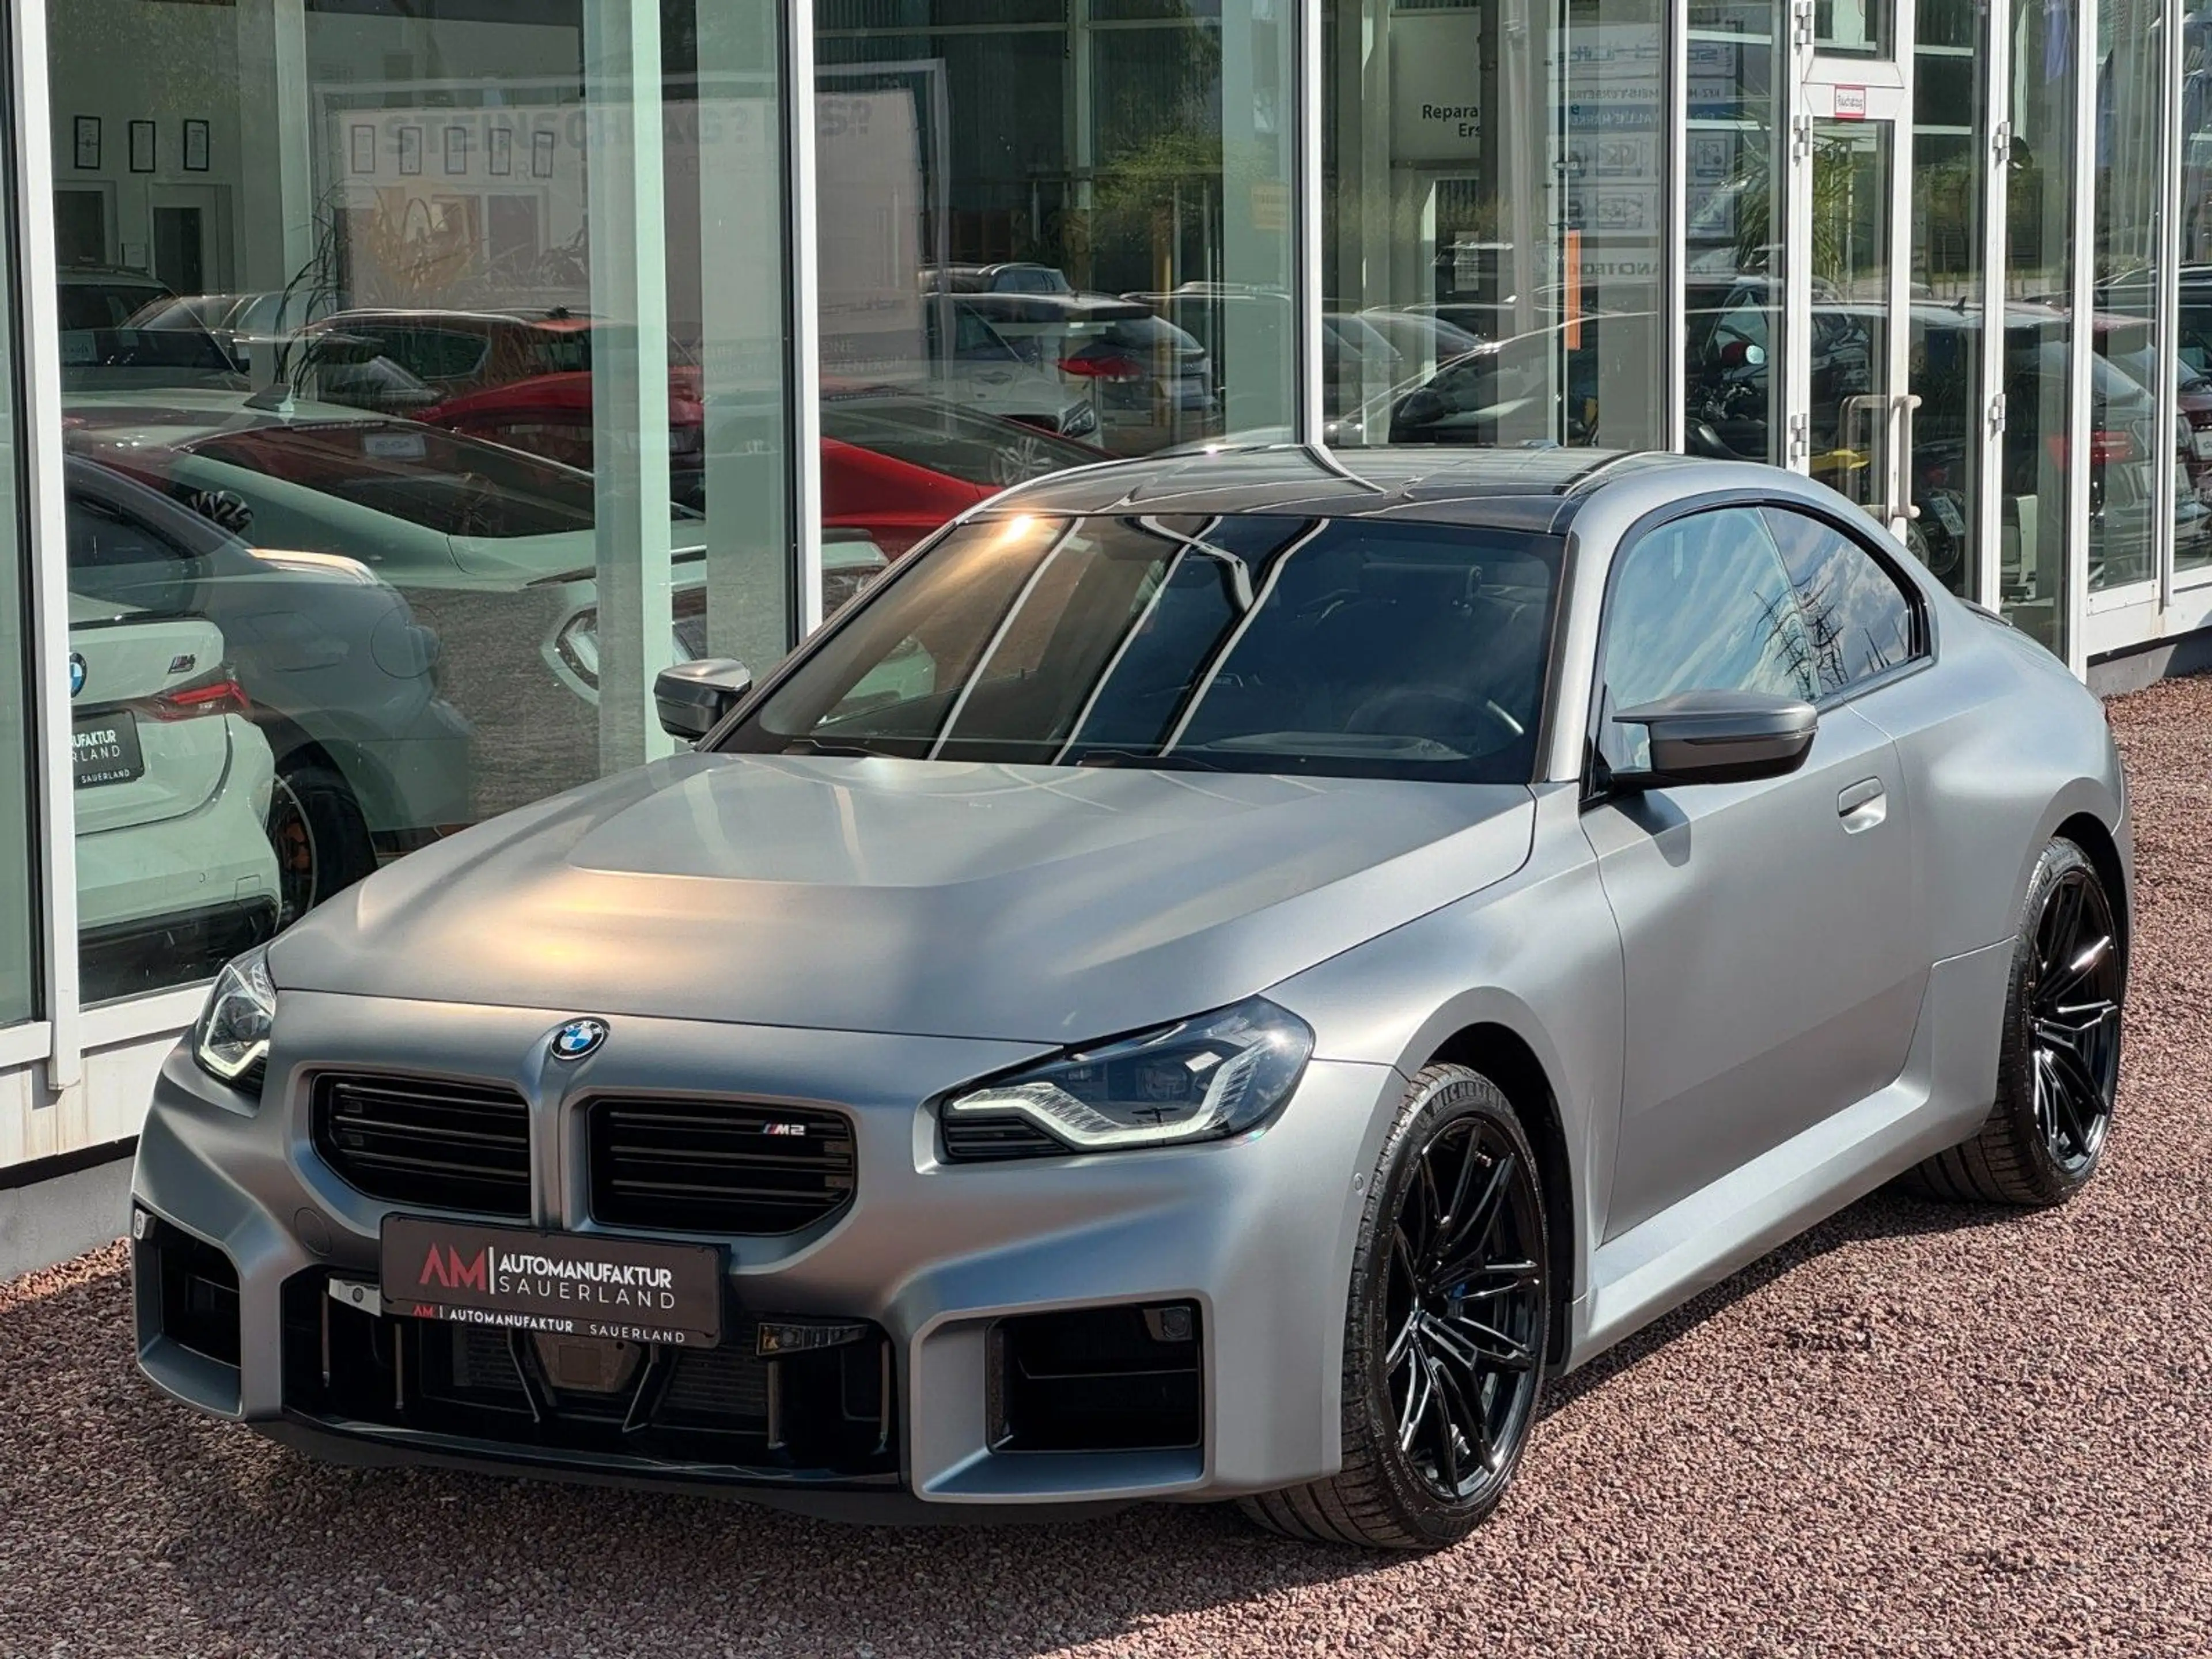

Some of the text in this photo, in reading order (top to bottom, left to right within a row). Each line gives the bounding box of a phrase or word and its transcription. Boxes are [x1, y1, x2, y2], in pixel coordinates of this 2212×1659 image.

[1422, 104, 1479, 122] Repara
[81, 768, 130, 783] SAUERLAND
[767, 1123, 805, 1136] M2
[419, 1243, 487, 1291] AM
[499, 1253, 672, 1289] AUTOMANUFAKTUR
[499, 1275, 675, 1309] SAUERLAND
[412, 1305, 685, 1343] AM AUTOMANUFAKTUR SAUERLAND
